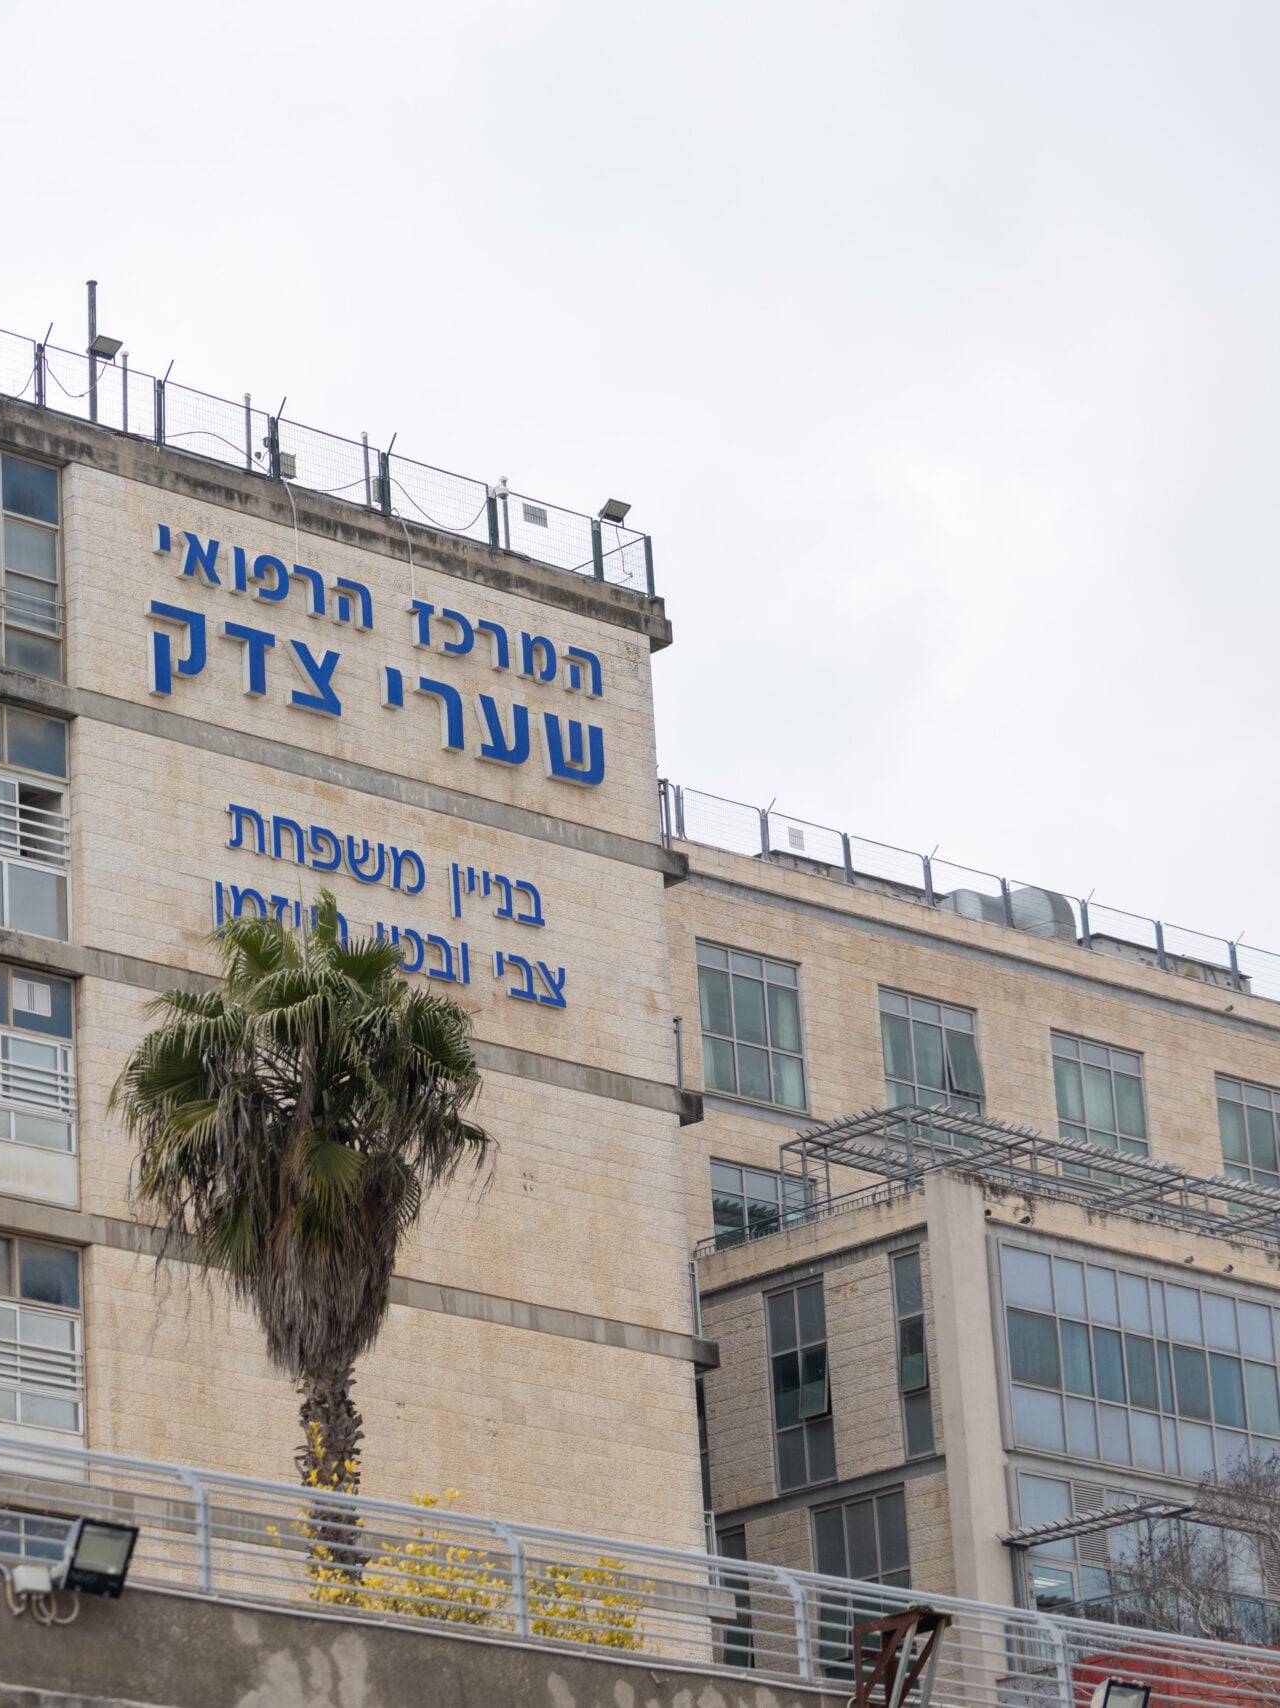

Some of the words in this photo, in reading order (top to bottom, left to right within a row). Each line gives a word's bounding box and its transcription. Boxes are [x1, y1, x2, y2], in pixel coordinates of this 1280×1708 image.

[152, 523, 373, 632] הרפואי
[145, 600, 342, 717] צדק
[407, 599, 603, 697] המרכז
[381, 666, 605, 786] שערי
[226, 803, 426, 895] משפחת
[449, 861, 546, 928] בניין
[492, 950, 568, 1009] צבי
